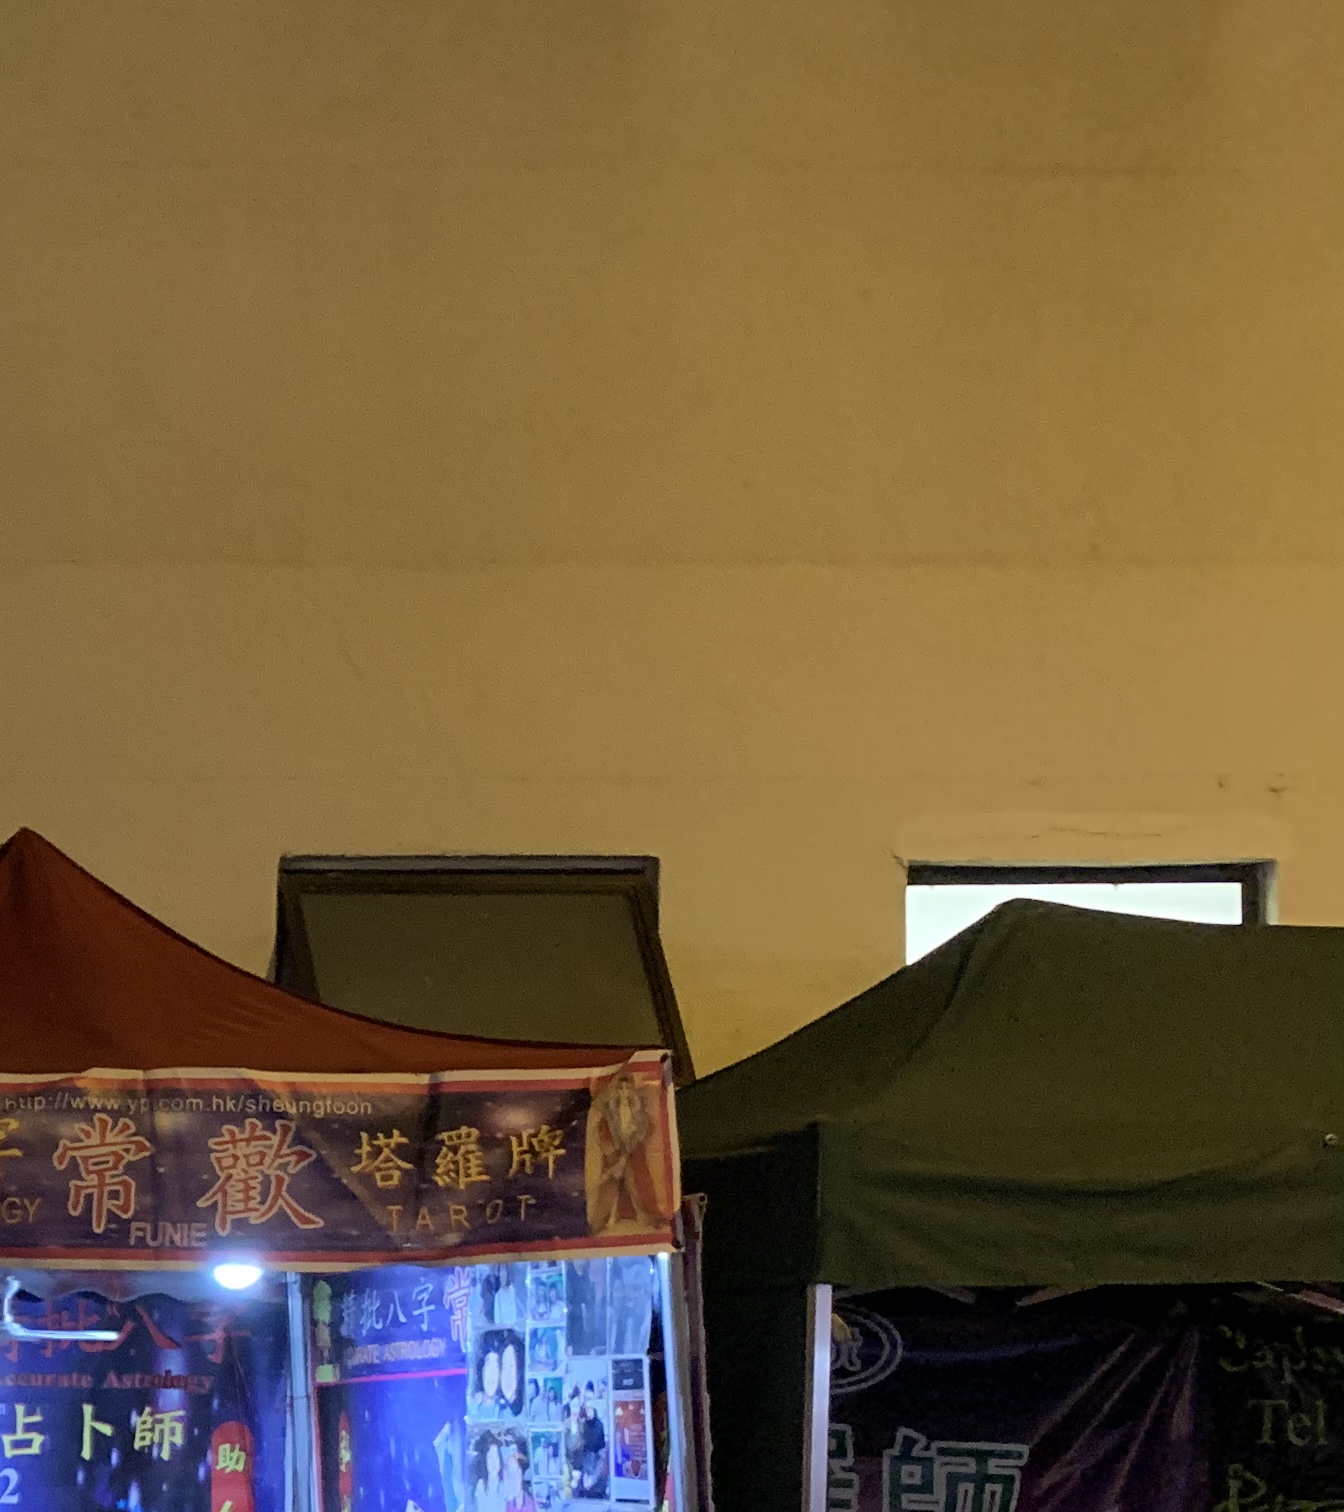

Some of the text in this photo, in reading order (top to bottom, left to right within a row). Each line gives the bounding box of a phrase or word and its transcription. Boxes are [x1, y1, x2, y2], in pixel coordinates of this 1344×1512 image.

[53, 1111, 325, 1238] 常歡
[350, 1123, 566, 1190] 塔羅牌
[386, 1194, 535, 1233] TAROT
[101, 1370, 215, 1394] Astrology
[1, 1402, 186, 1461] 占卜師
[1247, 1399, 1328, 1447] Tel
